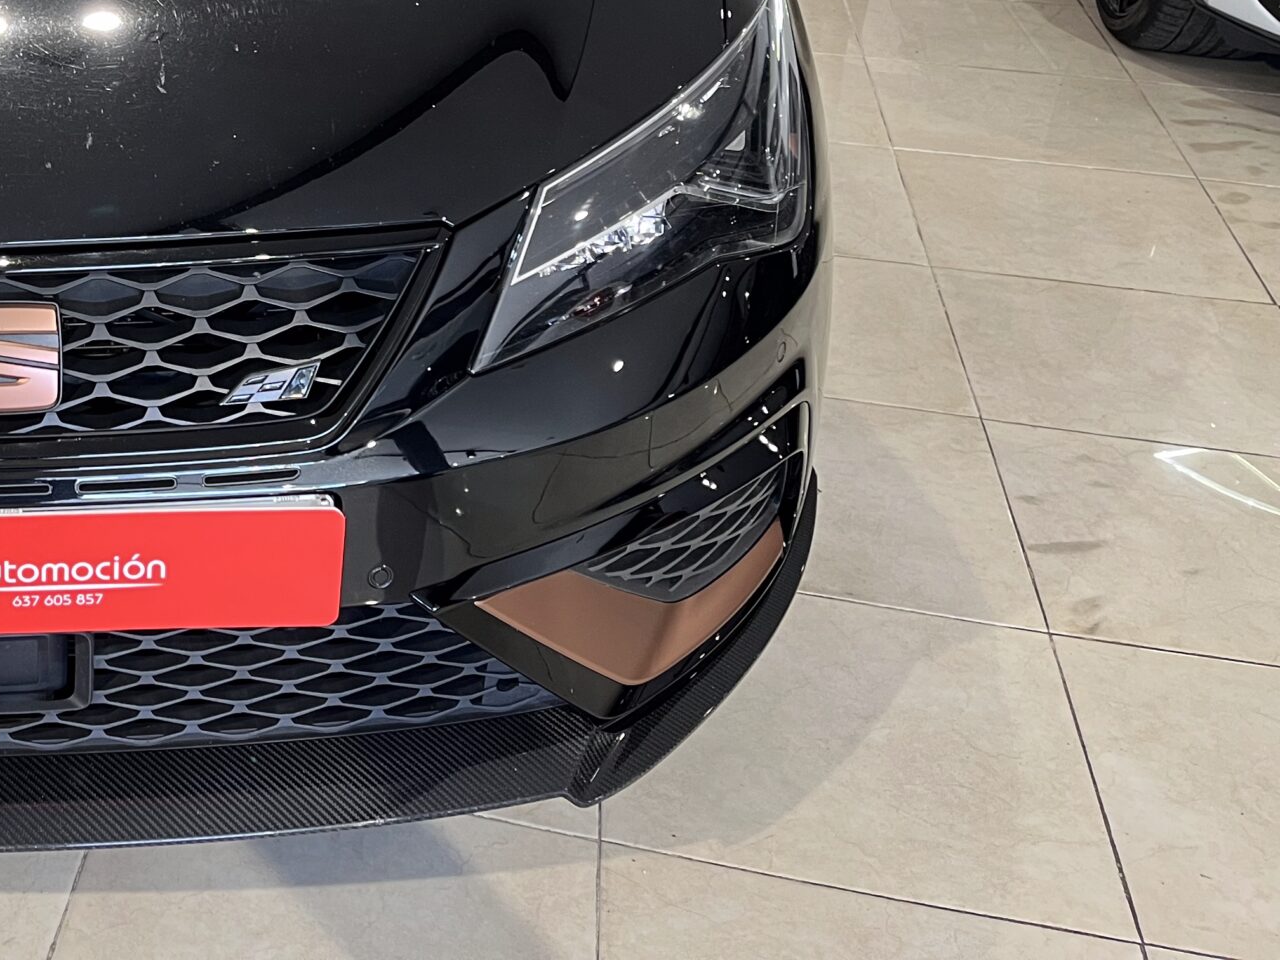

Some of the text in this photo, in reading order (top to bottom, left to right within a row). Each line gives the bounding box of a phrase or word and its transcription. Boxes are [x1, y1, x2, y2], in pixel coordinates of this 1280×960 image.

[12, 592, 104, 607] 637 605 857
